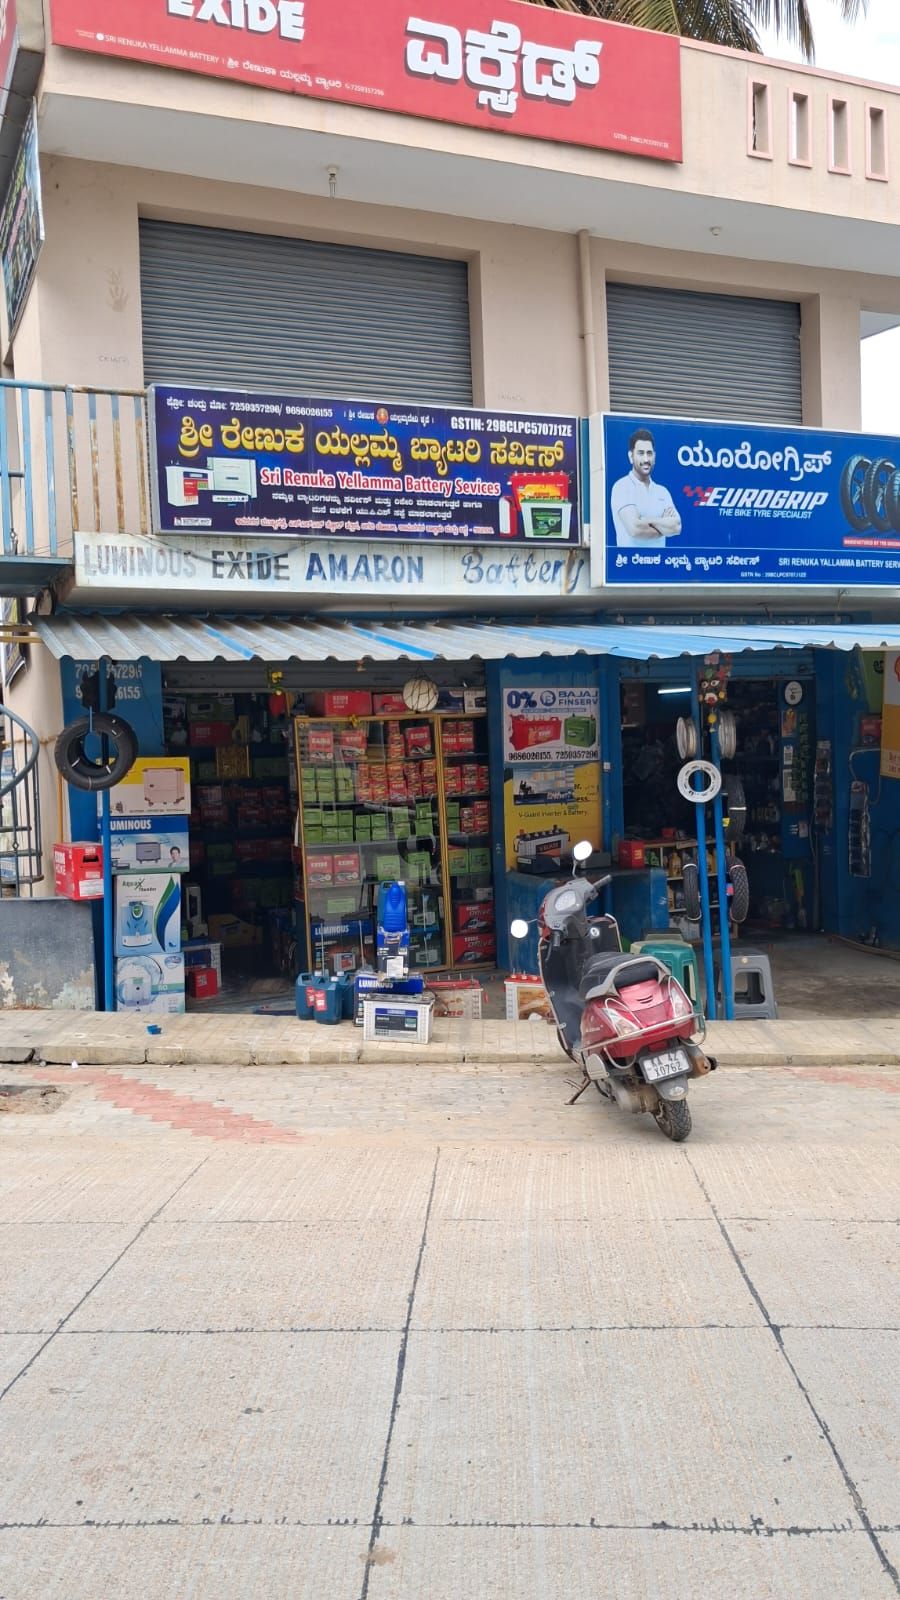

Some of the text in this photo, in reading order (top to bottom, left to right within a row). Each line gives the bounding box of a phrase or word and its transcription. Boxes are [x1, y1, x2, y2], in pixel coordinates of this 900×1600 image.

[104, 34, 116, 43] SRI
[117, 37, 147, 49] RENUKA
[147, 42, 188, 57] YELLAMMA
[189, 49, 219, 64] BATTERY
[285, 407, 333, 418] 9686026155
[450, 416, 485, 431] GSTIN:
[178, 415, 214, 458] ಶ್ರೀ
[220, 418, 305, 454] ರೇಣುಕ
[315, 424, 404, 471] ಯಲ್ಲಮ್ಮ
[410, 435, 482, 476] ಬ್ಯಾಟರಿ
[677, 439, 833, 482] ಯೂರೋಗ್ರಿಪ್
[260, 466, 501, 497] Sri Renuka Yellamma Battery Sevices
[704, 486, 829, 510] EUROGRIP
[718, 508, 812, 519] THE BIKE TYRE SPECIALIST
[83, 543, 290, 580] LUMINOUS EXIDE
[615, 553, 628, 568] ಶ್ರೀ
[631, 553, 661, 565] ರೇಣುಕ
[694, 555, 723, 571] ಬ್ಯಾಟರಿ
[778, 557, 790, 566] SRI
[791, 557, 819, 567] RENUKA
[819, 558, 855, 568] YALLAMMA
[855, 559, 884, 568] BATTERY
[305, 549, 585, 594] AMARON Battery
[507, 690, 537, 709] 0%
[558, 690, 598, 698] BAJAJ
[558, 698, 598, 706] FINSERV
[110, 819, 152, 831] UMINOUS
